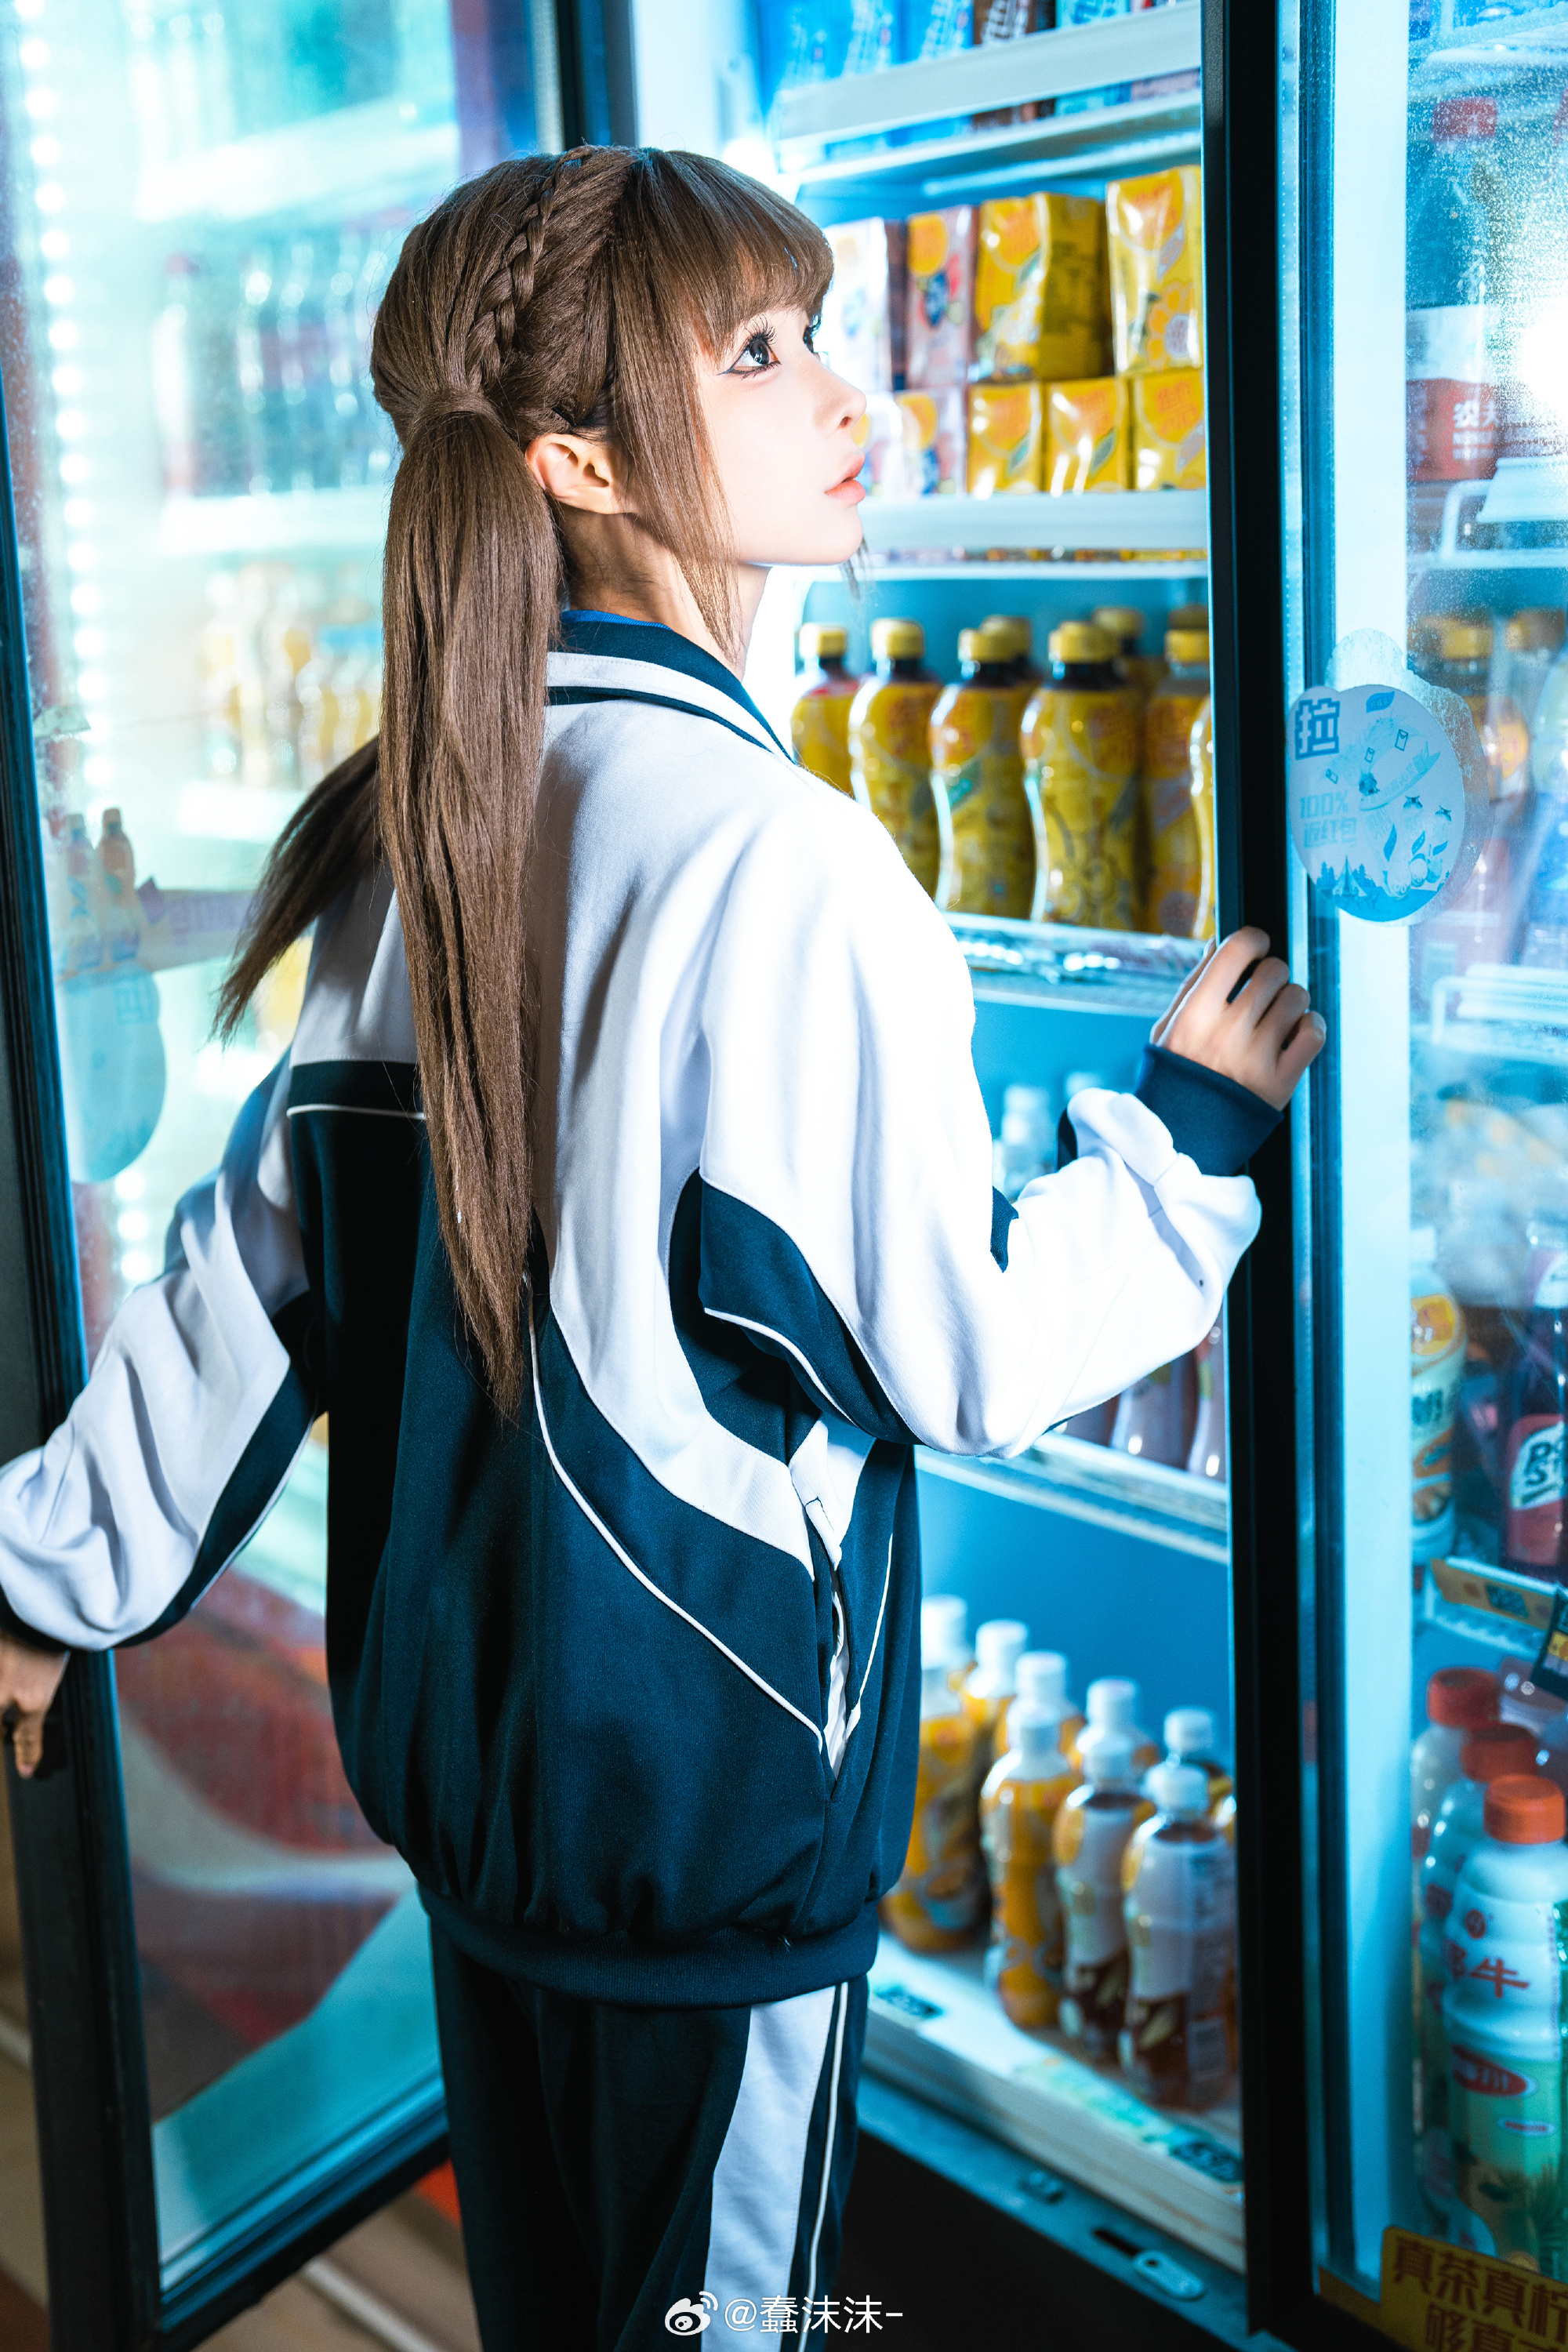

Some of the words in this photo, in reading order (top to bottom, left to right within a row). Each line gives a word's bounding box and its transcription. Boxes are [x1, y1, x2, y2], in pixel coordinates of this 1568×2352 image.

[1294, 697, 1341, 760] 拉
[1300, 789, 1348, 819] 100%
[1304, 816, 1356, 848] 返红包
